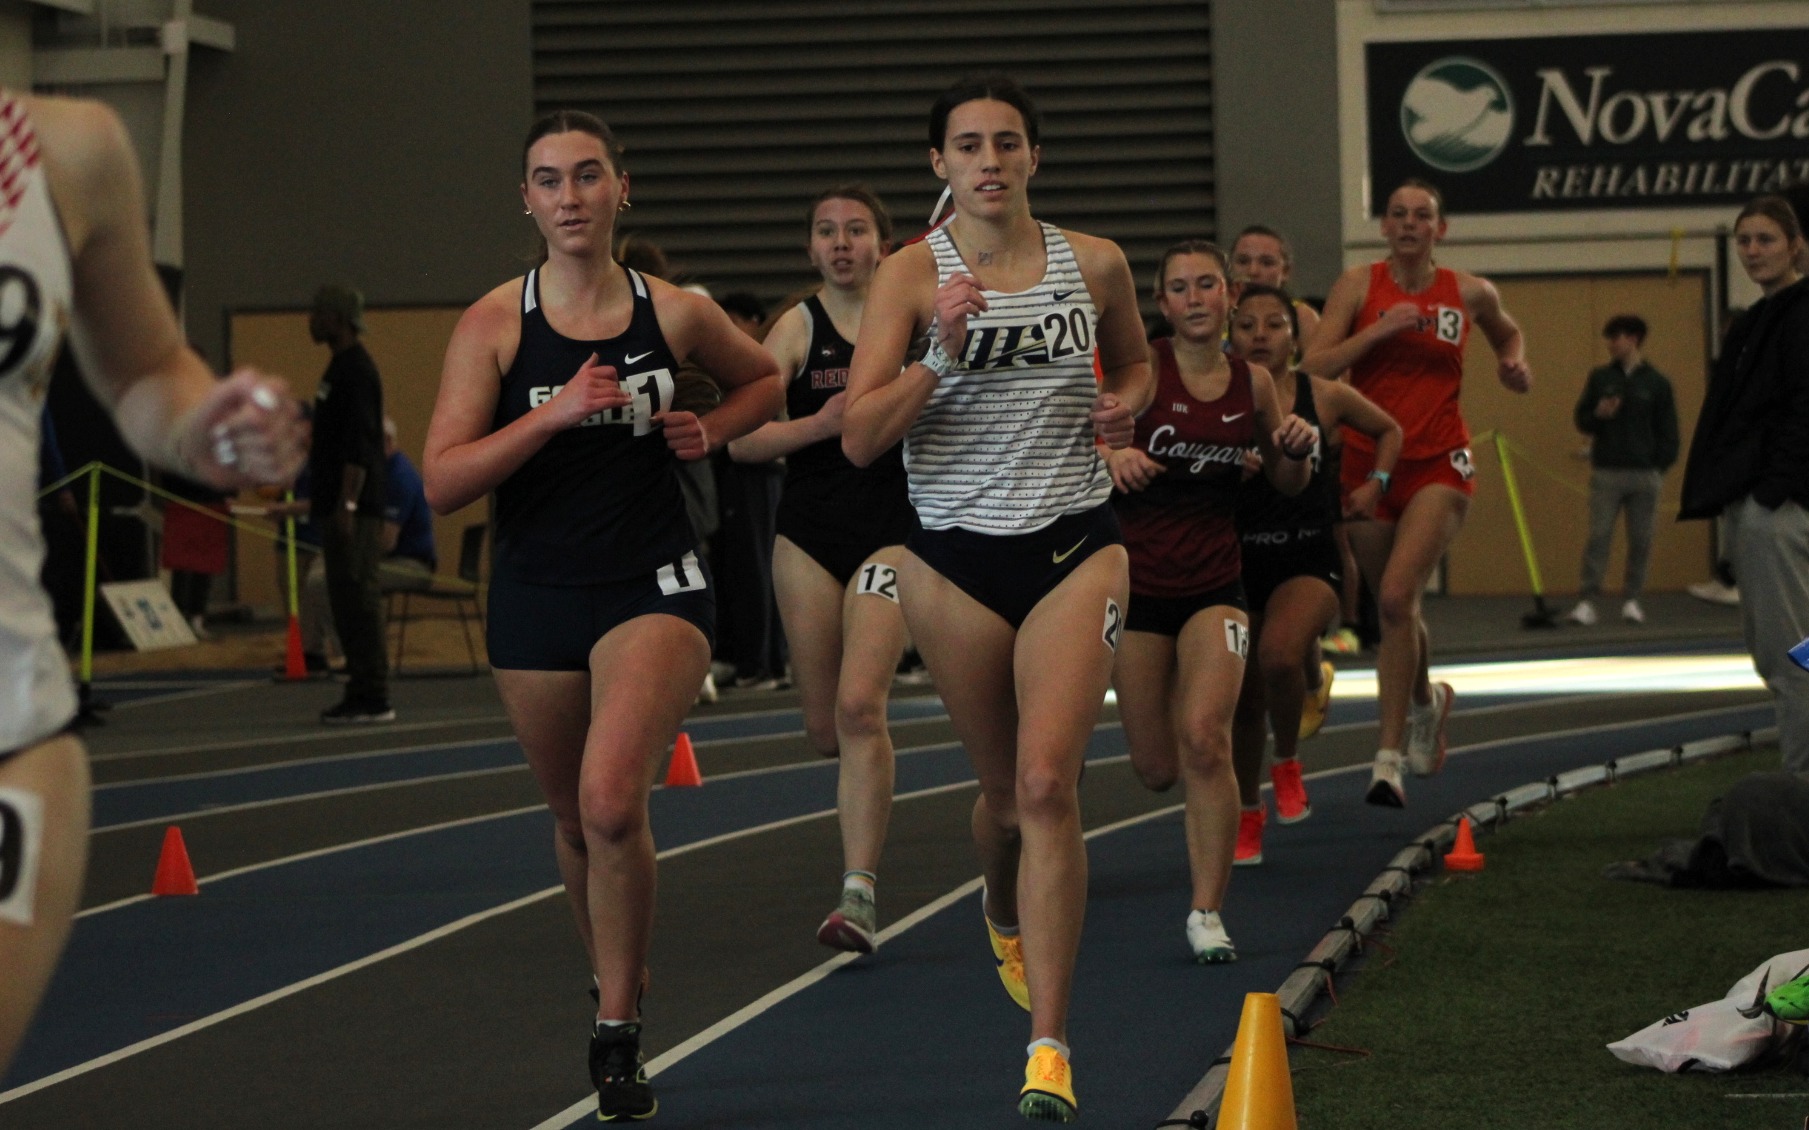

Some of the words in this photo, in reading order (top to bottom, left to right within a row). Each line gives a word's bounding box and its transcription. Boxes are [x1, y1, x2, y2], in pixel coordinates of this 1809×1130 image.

[1044, 307, 1090, 358] 20
[1442, 310, 1459, 340] 3
[637, 375, 660, 418] 1
[1148, 425, 1259, 473] Cougar
[864, 564, 896, 599] 12
